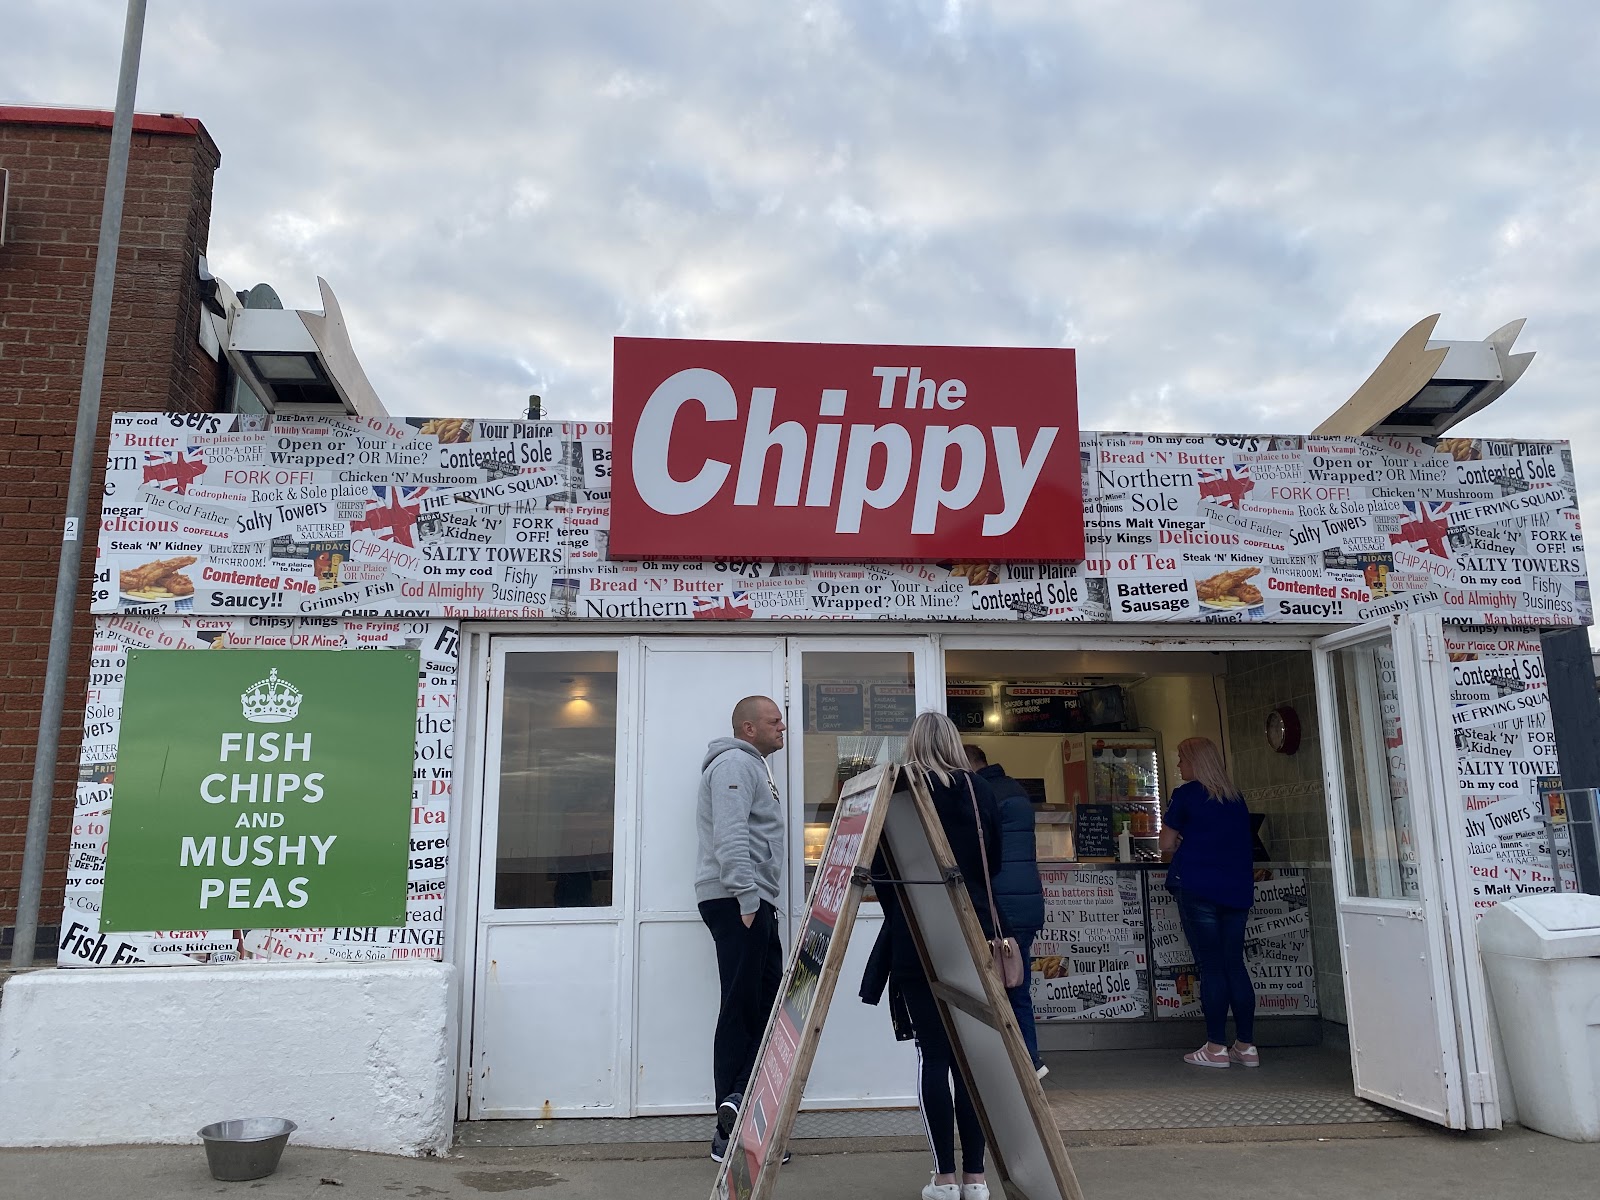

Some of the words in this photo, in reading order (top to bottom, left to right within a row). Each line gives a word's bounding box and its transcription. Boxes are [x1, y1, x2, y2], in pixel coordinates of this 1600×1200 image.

[872, 367, 967, 410] The
[115, 418, 133, 426] my
[274, 426, 299, 435] Whitby
[302, 427, 329, 436] Scampi
[479, 423, 510, 438] Your
[513, 423, 552, 438] Plaice
[125, 434, 178, 447] Butter
[210, 434, 242, 445] plaice
[278, 438, 324, 452] Open
[329, 442, 345, 450] or
[357, 437, 387, 450] Your
[359, 452, 382, 463] OR
[386, 453, 427, 464] Mine?
[440, 444, 515, 469] Contented
[521, 441, 551, 463] Sole
[632, 368, 1059, 536] Chippy
[1101, 452, 1144, 464] Bread
[1178, 452, 1225, 465] Butter
[270, 452, 354, 467] Wrapped?
[224, 471, 269, 484] FORK
[276, 471, 313, 484] OFF!
[339, 471, 387, 483] Chicken
[412, 473, 477, 484] Mushroom
[1097, 470, 1193, 488] Northern
[188, 489, 246, 501] Codrophenia
[252, 490, 284, 502] Rock
[287, 487, 297, 499] &
[300, 486, 327, 498] Sole
[331, 484, 368, 500] plaice
[421, 494, 448, 512] THE
[455, 486, 505, 503] FRYING
[507, 475, 558, 493] SQUAD!
[1272, 487, 1312, 499] FORK
[1317, 487, 1349, 500] OFF!
[144, 493, 165, 505] The
[167, 500, 190, 514] Cod
[193, 507, 229, 525] Father
[1132, 493, 1178, 511] Sole
[1449, 510, 1471, 525] THE
[1475, 500, 1520, 518] FRYING
[1522, 490, 1564, 508] SQUAD!
[236, 511, 272, 533] Salty
[276, 503, 326, 523] Towers
[338, 510, 362, 518] KINGS
[441, 513, 476, 528] Steak
[67, 521, 74, 531] 2
[512, 519, 553, 529] FORK
[1126, 518, 1154, 528] Malt
[1158, 519, 1205, 530] Vinegar
[1205, 508, 1225, 520] The
[1227, 514, 1247, 528] Cod
[1250, 521, 1283, 537] Father
[183, 527, 228, 538] CODFELLAS
[445, 527, 492, 544] Kidney
[516, 532, 550, 542] OFF!
[1159, 530, 1239, 544] Delicious
[1290, 523, 1320, 546] Salty
[1324, 517, 1366, 536] Towers
[111, 542, 142, 550] Steak
[165, 542, 202, 552] Kidney
[423, 548, 480, 562] SALTY
[486, 548, 562, 562] TOWERS
[343, 564, 361, 572] Your
[364, 564, 387, 573] Plaice
[643, 562, 658, 570] Oh
[661, 564, 679, 572] my
[1086, 559, 1111, 574] up
[1119, 553, 1136, 571] of
[1142, 554, 1176, 571] Tea
[1456, 558, 1508, 572] SALTY
[1512, 559, 1580, 572] TOWERS
[361, 572, 384, 580] Mine?
[424, 566, 441, 575] Oh
[445, 568, 465, 577] my
[470, 567, 492, 575] cod
[505, 567, 537, 586] Fishy
[1007, 564, 1037, 579] Your
[1039, 564, 1076, 579] Plaice
[202, 567, 279, 588] Contented
[285, 578, 316, 594] Sole
[590, 578, 637, 591] Bread
[673, 578, 723, 592] Butter
[1461, 575, 1477, 584] Oh
[1481, 578, 1497, 586] my
[1501, 576, 1521, 585] cod
[401, 584, 424, 597] Cod
[428, 584, 484, 602] Almighty
[818, 582, 862, 594] Open
[866, 585, 881, 593] or
[1117, 580, 1188, 597] Battered
[211, 592, 282, 609] Saucy!!
[300, 589, 361, 613] Grimsby
[365, 582, 394, 596] Fish
[972, 584, 1042, 610] Contented
[1049, 581, 1077, 604] Sole
[1444, 592, 1465, 605] Cod
[1469, 592, 1516, 608] Almighty
[586, 598, 687, 618] Northern
[812, 595, 891, 611] Wrapped?
[1121, 599, 1190, 613] Sausage
[1280, 601, 1343, 615] Saucy!!
[444, 606, 469, 617] Man
[472, 606, 523, 617] batters
[527, 606, 544, 618] fish
[108, 617, 154, 639] plaice
[158, 632, 172, 646] to
[344, 622, 362, 630] The
[366, 623, 399, 632] Frying
[1472, 701, 1516, 719] FRYING
[1467, 729, 1496, 742] Steak
[220, 732, 311, 762] FISH
[200, 773, 324, 804] CHIPS
[235, 813, 284, 828] AND
[412, 806, 446, 824] Tea
[1489, 805, 1530, 830] Towers
[180, 835, 337, 866] MUSHY
[200, 878, 309, 908] PEAS
[1484, 884, 1511, 894] Malt
[1080, 911, 1119, 922] Butter
[1267, 914, 1303, 931] FRYING
[60, 922, 108, 964] Fish
[154, 944, 182, 953] Cods
[186, 943, 232, 951] Kitchen
[1071, 944, 1109, 954] Saucy!!
[1073, 960, 1095, 972] Your
[1099, 959, 1129, 972] Plaice
[1251, 965, 1292, 978] SALTY
[1047, 974, 1103, 1000] Contented
[1106, 973, 1130, 993] Sole
[1260, 996, 1299, 1009] Almighty
